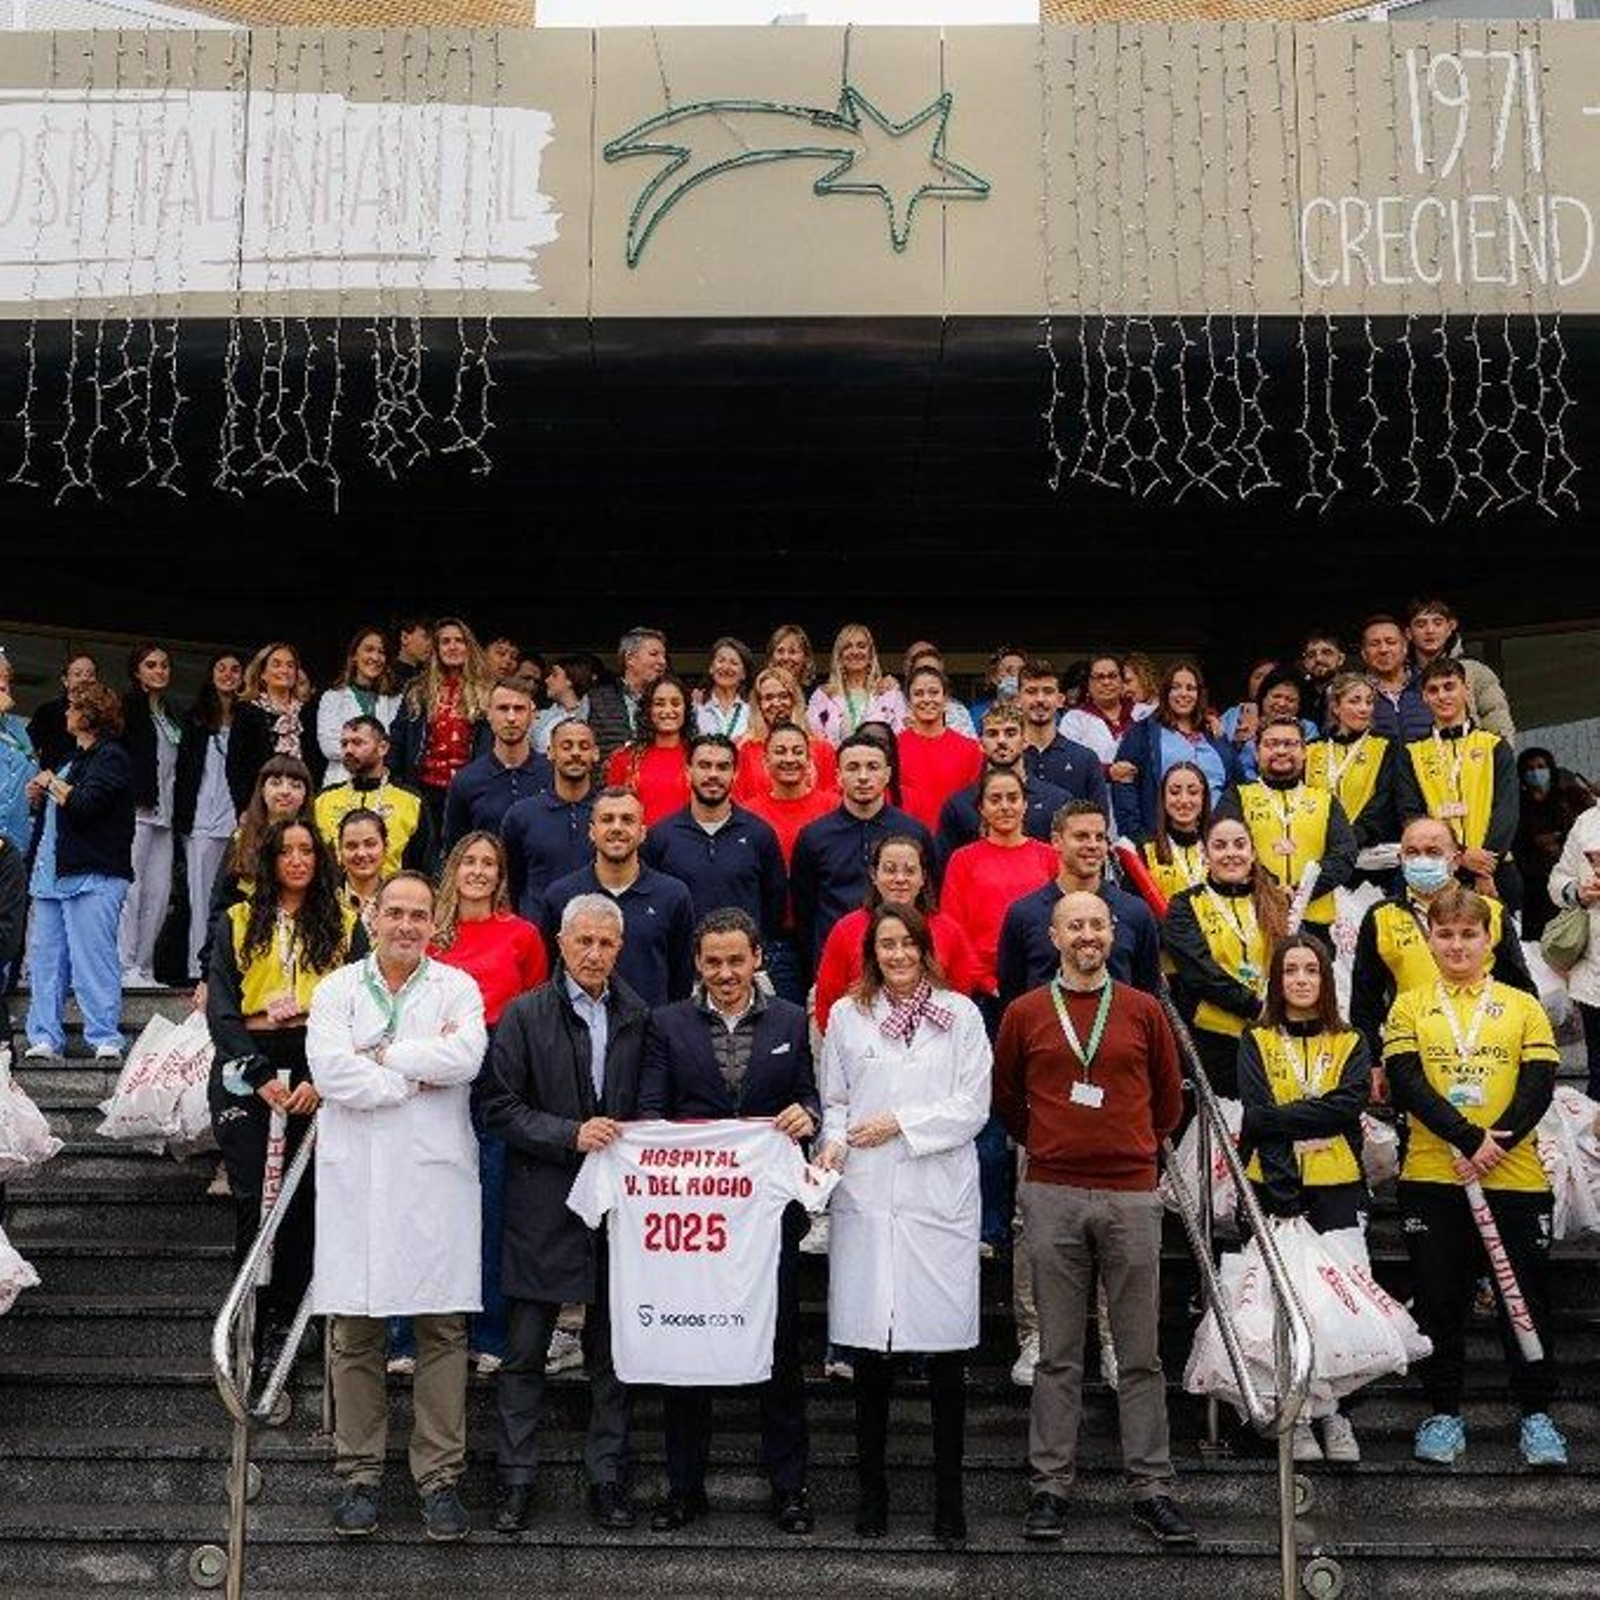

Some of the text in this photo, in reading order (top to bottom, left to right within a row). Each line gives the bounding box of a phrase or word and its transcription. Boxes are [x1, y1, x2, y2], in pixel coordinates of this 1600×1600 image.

[1405, 46, 1542, 178] 1971
[262, 125, 527, 225] INFANTIL
[1301, 195, 1594, 286] CRECIEND
[625, 1174, 753, 1198] V. DEL ROCIO
[639, 1148, 740, 1168] HOSPITAL
[644, 1212, 727, 1252] 2025
